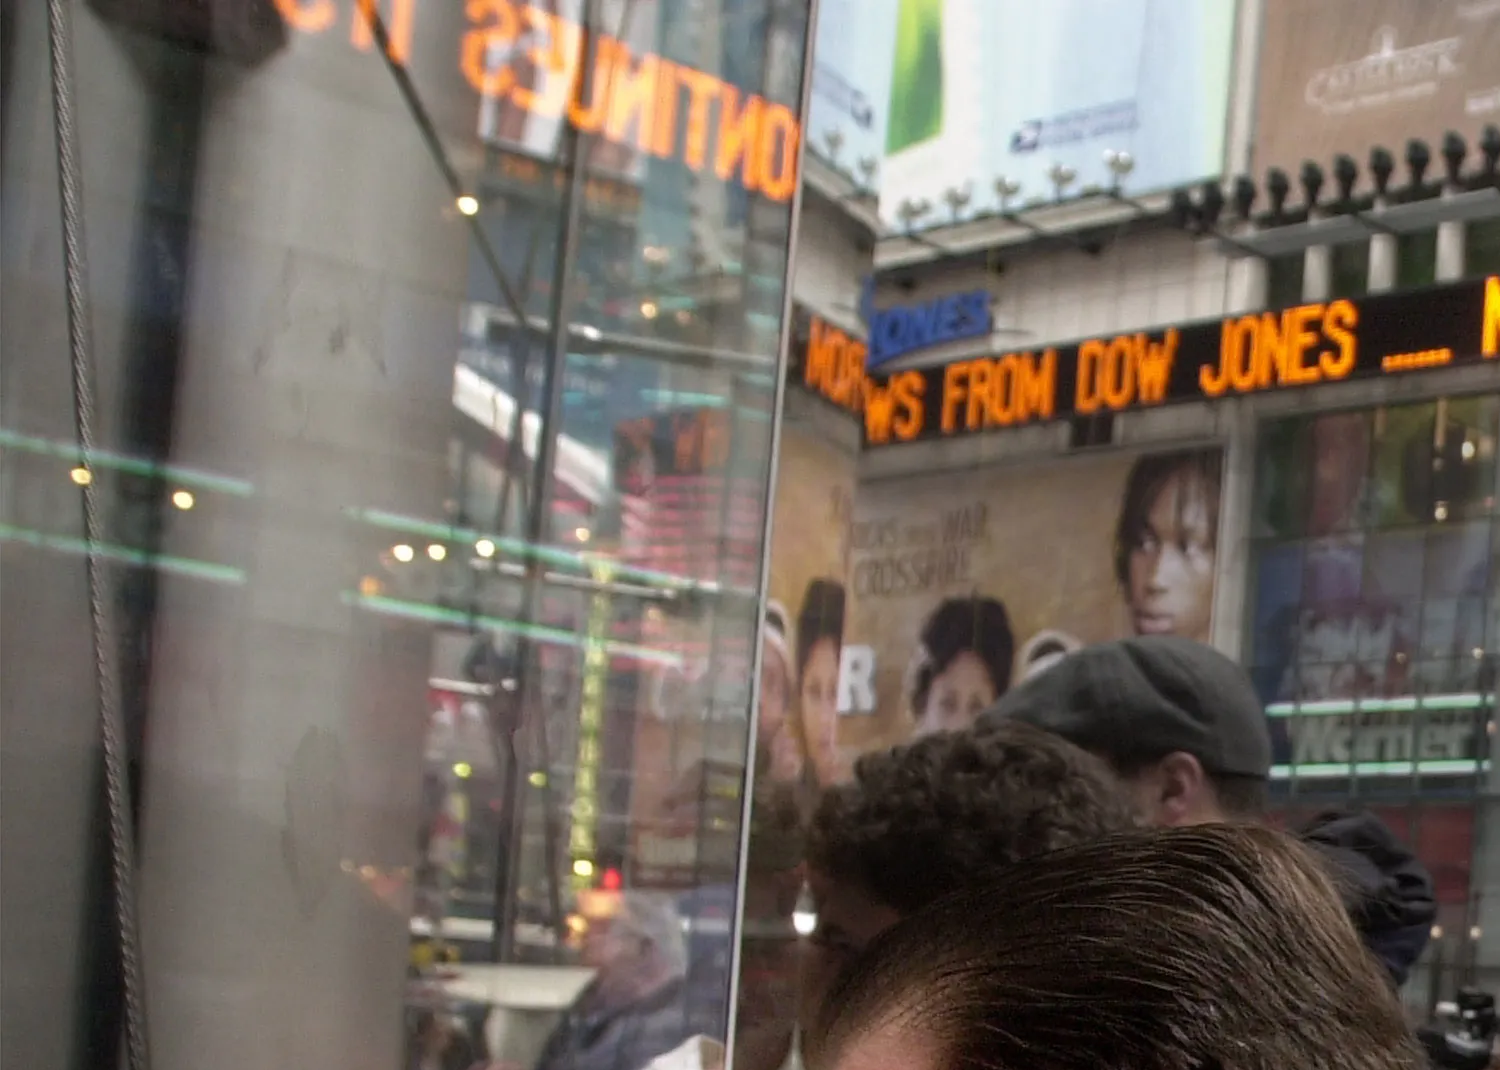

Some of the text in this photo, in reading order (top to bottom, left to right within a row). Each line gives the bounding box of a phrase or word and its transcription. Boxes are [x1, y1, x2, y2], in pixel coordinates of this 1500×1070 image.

[941, 348, 1057, 433] FROM
[1075, 328, 1178, 414] DOW
[1199, 299, 1359, 397] JONES
